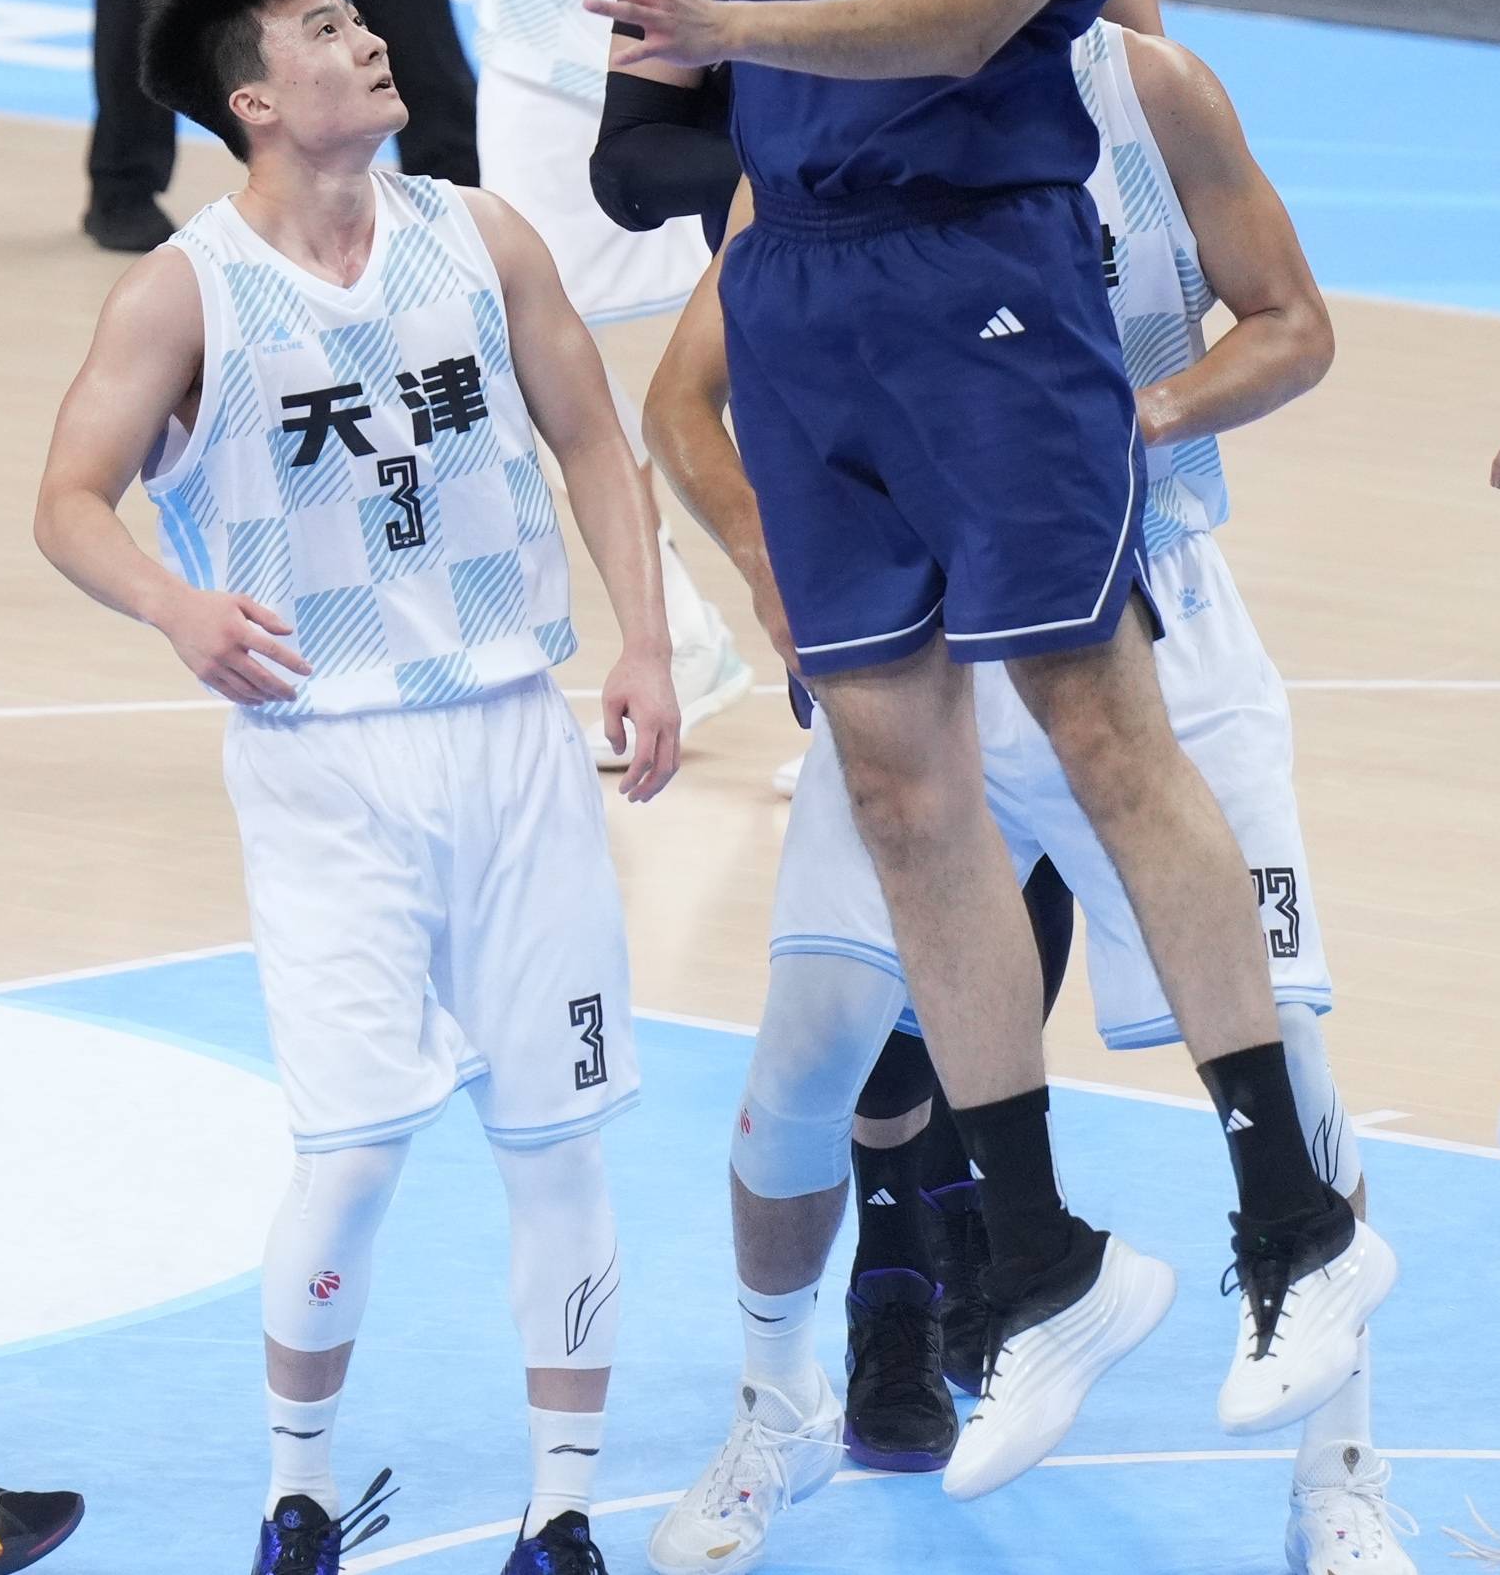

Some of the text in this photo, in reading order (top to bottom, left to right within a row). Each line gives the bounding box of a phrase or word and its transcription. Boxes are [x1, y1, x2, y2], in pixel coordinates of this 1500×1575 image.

[280, 354, 490, 468] 天津
[376, 455, 428, 552] 3
[568, 992, 608, 1091] 3
